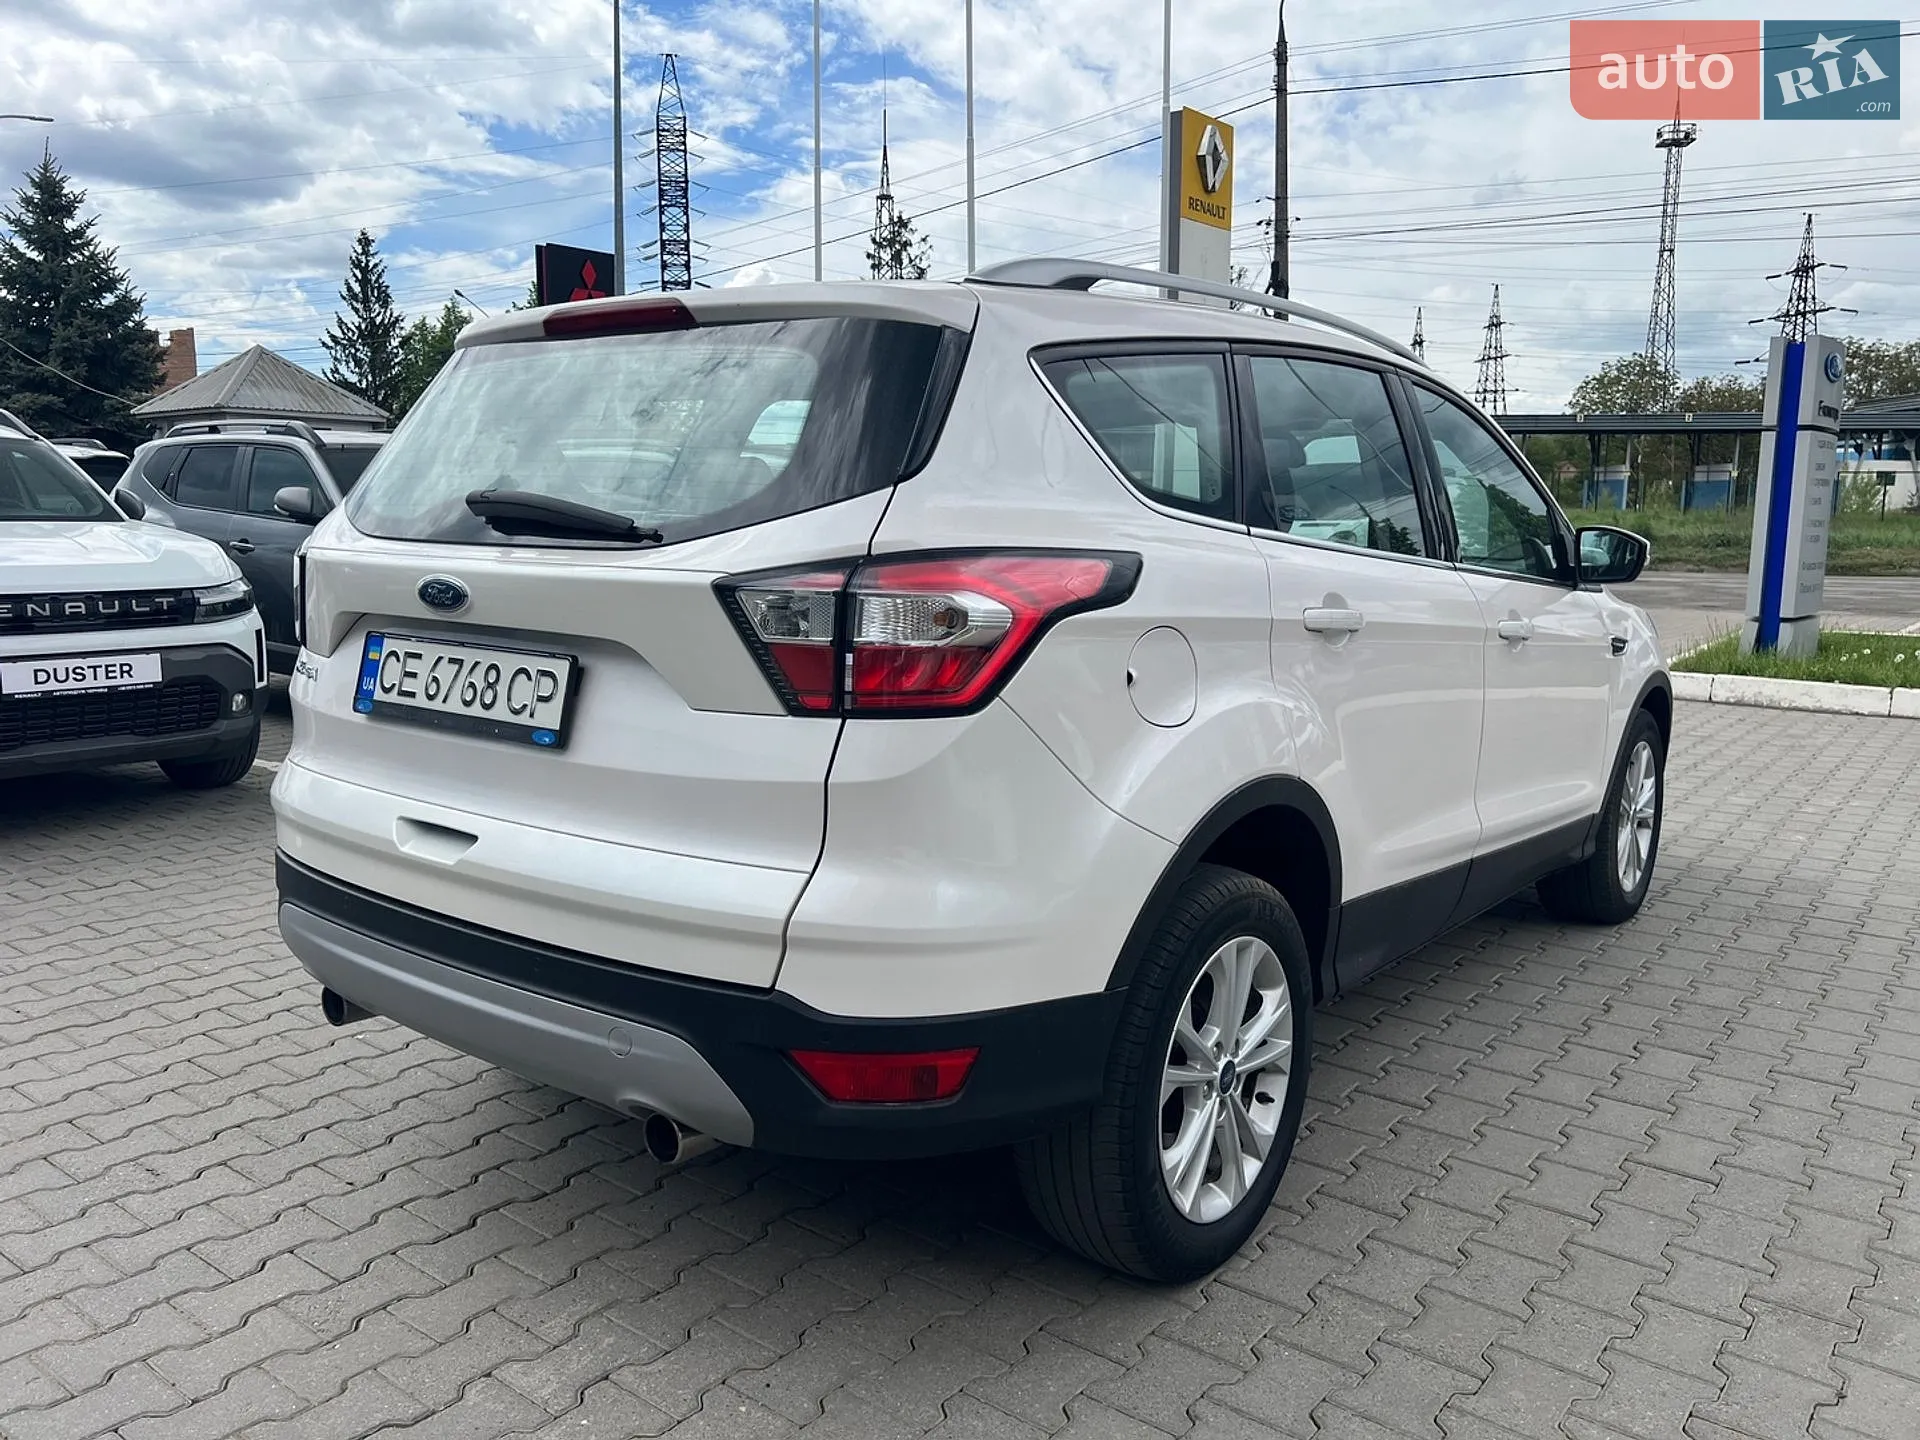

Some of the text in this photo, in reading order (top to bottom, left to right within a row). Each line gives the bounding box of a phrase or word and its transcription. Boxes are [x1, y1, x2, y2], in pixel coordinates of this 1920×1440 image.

[1188, 196, 1226, 219] RENAULT
[33, 662, 134, 685] DUSTER
[362, 676, 375, 691] UA
